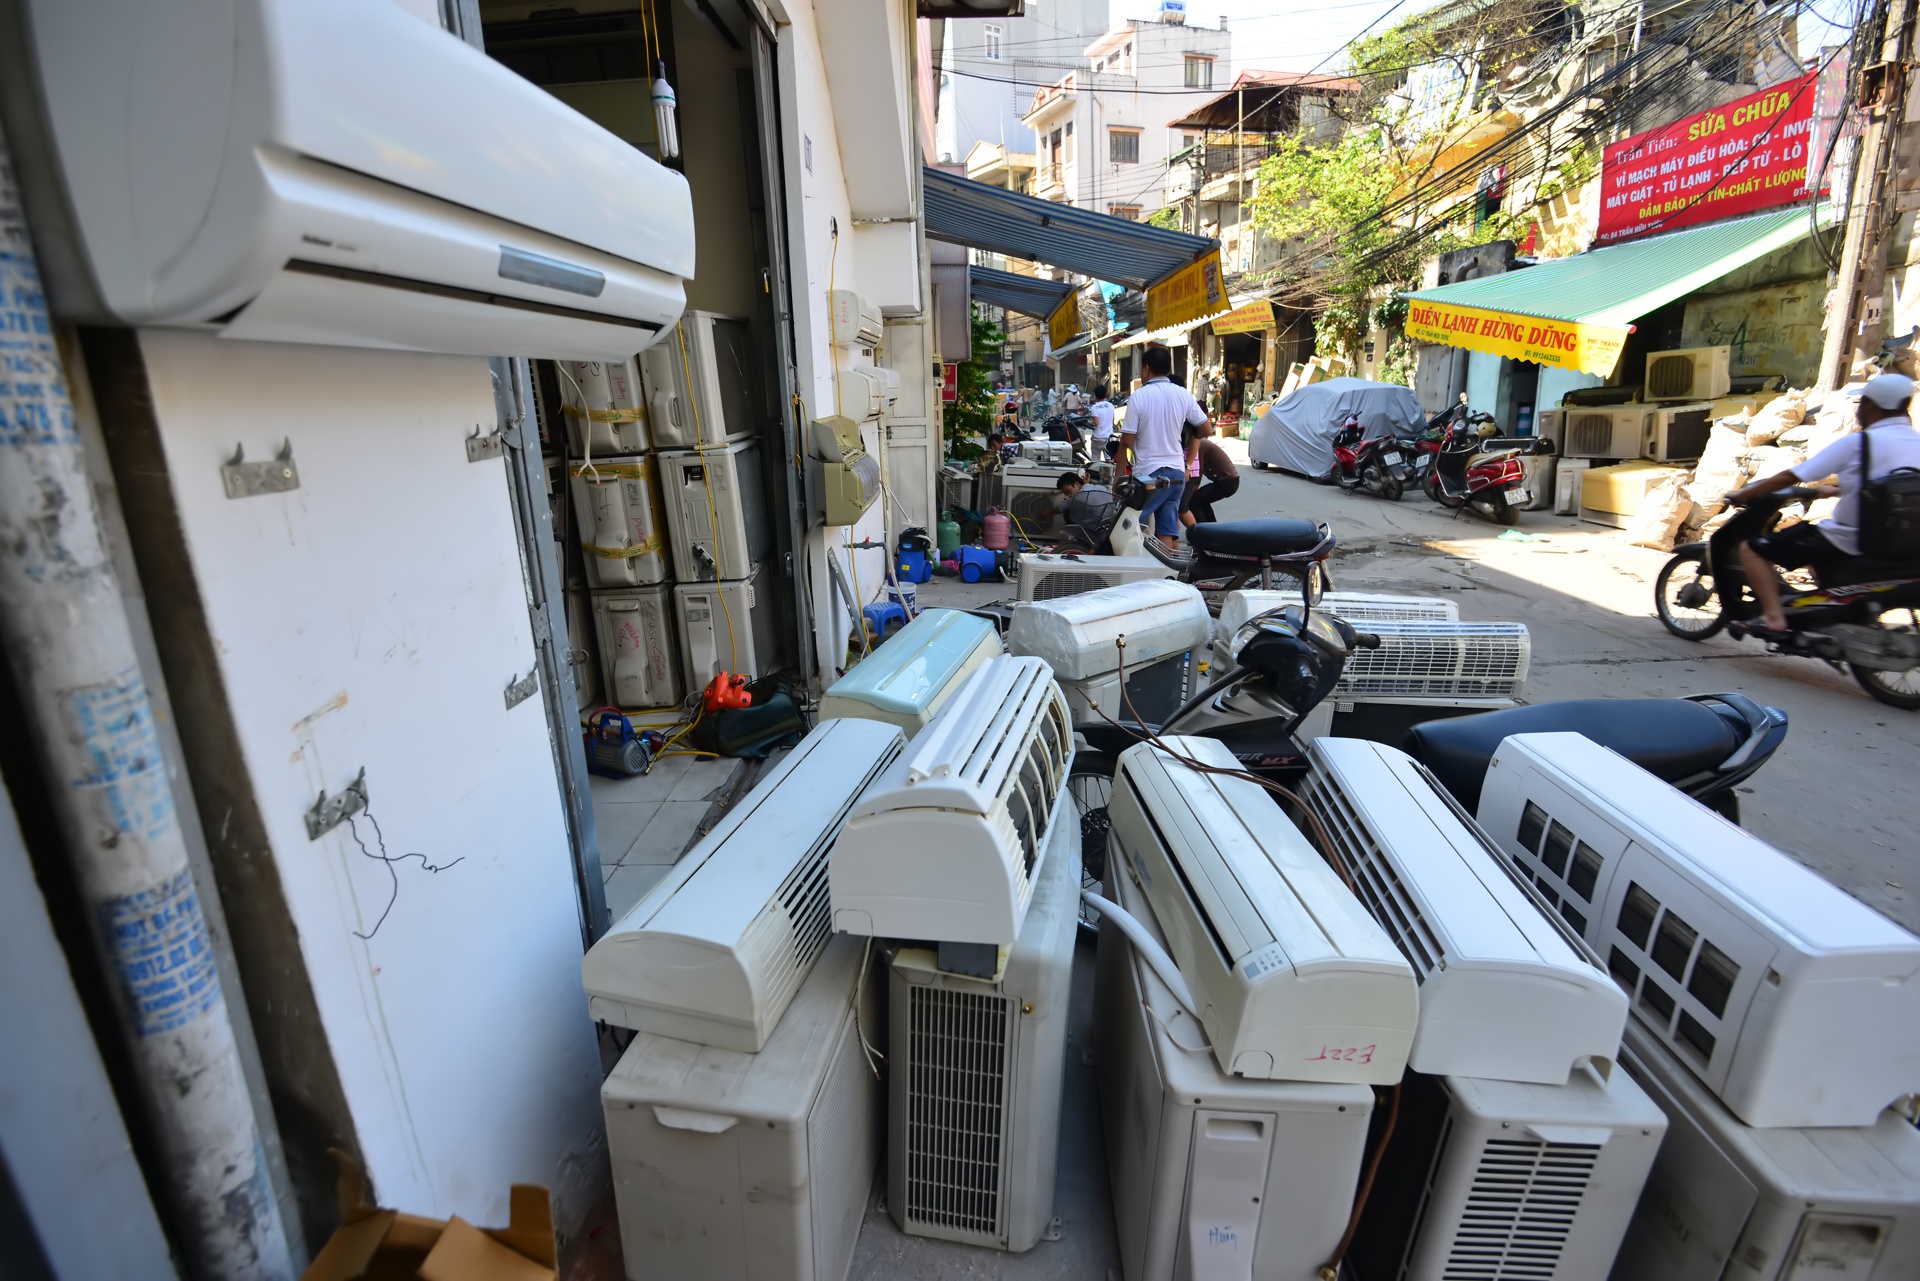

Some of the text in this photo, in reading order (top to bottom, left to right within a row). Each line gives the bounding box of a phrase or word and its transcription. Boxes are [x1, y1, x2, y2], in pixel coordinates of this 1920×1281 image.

[1615, 91, 1791, 165] Trần Tiến: SỬA CHỮA
[1606, 194, 1628, 209] MÁY
[1630, 185, 1653, 203] GIẶT
[1663, 175, 1677, 194] TỦ
[1680, 169, 1712, 191] LẠNH
[1752, 150, 1772, 169] TỪ
[1783, 141, 1802, 161] LÒ
[1628, 165, 1658, 184] MẠCH
[1660, 156, 1685, 175] MÁY
[1687, 145, 1716, 167] ĐIỀU
[1718, 138, 1749, 158] HÒA:
[1639, 202, 1661, 219] ĐẢM
[1664, 195, 1686, 213] BẢO
[1707, 174, 1761, 202] TÍN-CHẤT
[1764, 166, 1808, 188] LƯỢNG
[1411, 307, 1577, 352] ĐIỆN LẠNH HÙNG DŨNG
